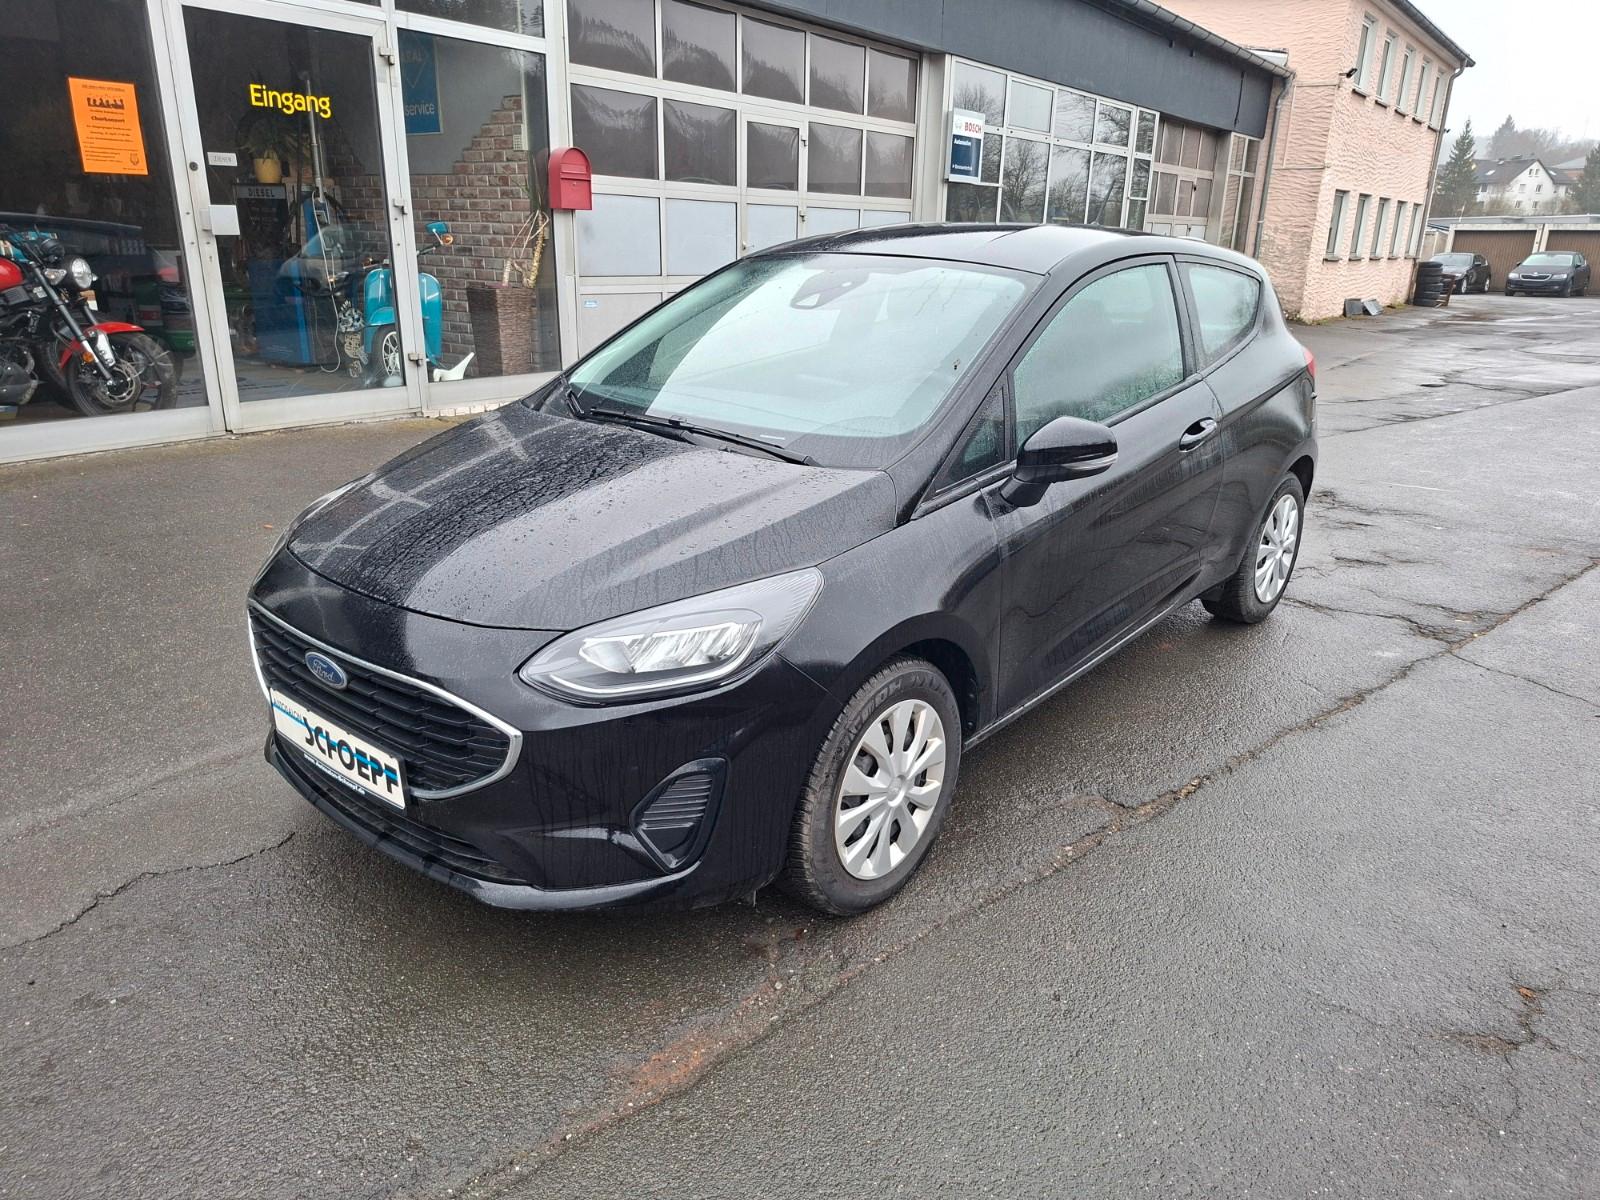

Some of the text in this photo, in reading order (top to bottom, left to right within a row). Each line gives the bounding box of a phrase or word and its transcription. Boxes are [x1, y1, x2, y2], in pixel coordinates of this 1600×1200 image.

[249, 84, 332, 119] Eingang
[405, 102, 435, 116] service
[965, 122, 981, 133] BOSCH
[248, 187, 275, 197] DIESEL
[312, 659, 335, 681] Ford
